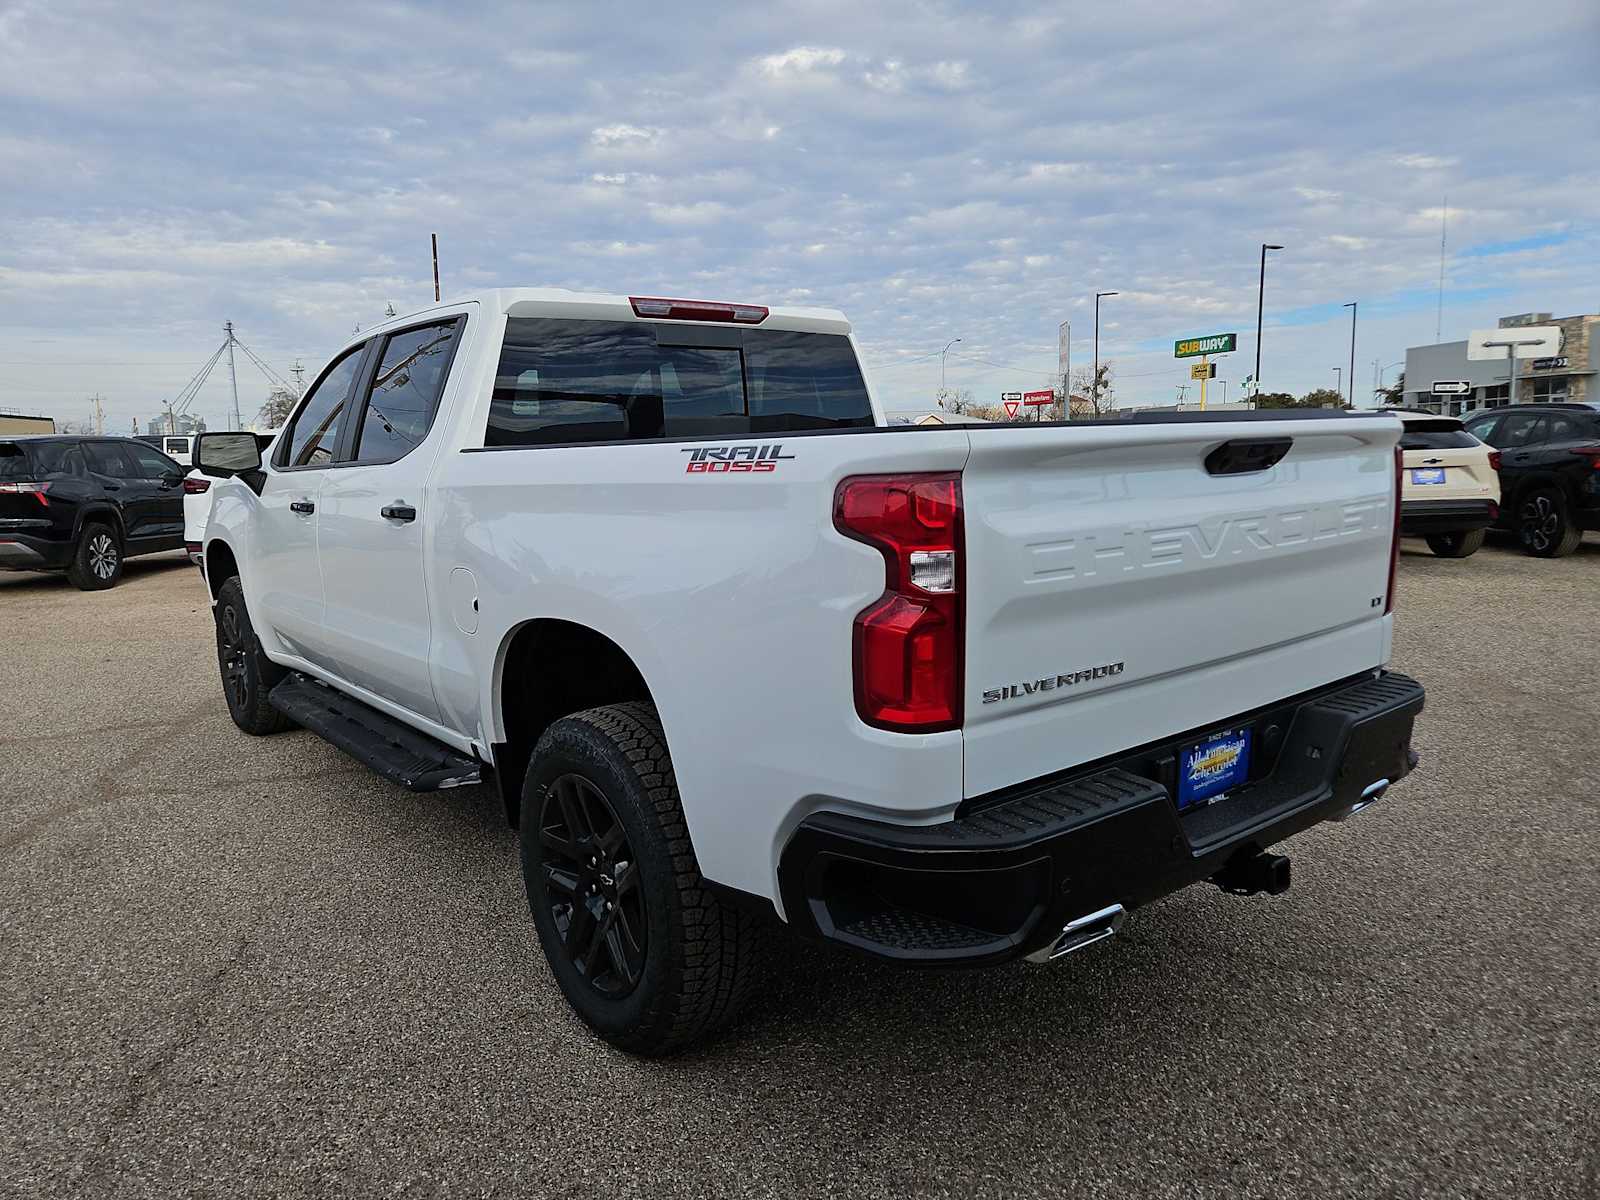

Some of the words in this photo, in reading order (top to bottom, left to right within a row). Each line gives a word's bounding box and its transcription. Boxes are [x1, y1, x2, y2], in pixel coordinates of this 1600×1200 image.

[1177, 337, 1229, 354] SUBWAY
[680, 445, 795, 461] TRAIL
[686, 460, 777, 472] BOSS
[1024, 498, 1388, 584] CHEVROLET
[982, 661, 1124, 704] SILVERADO
